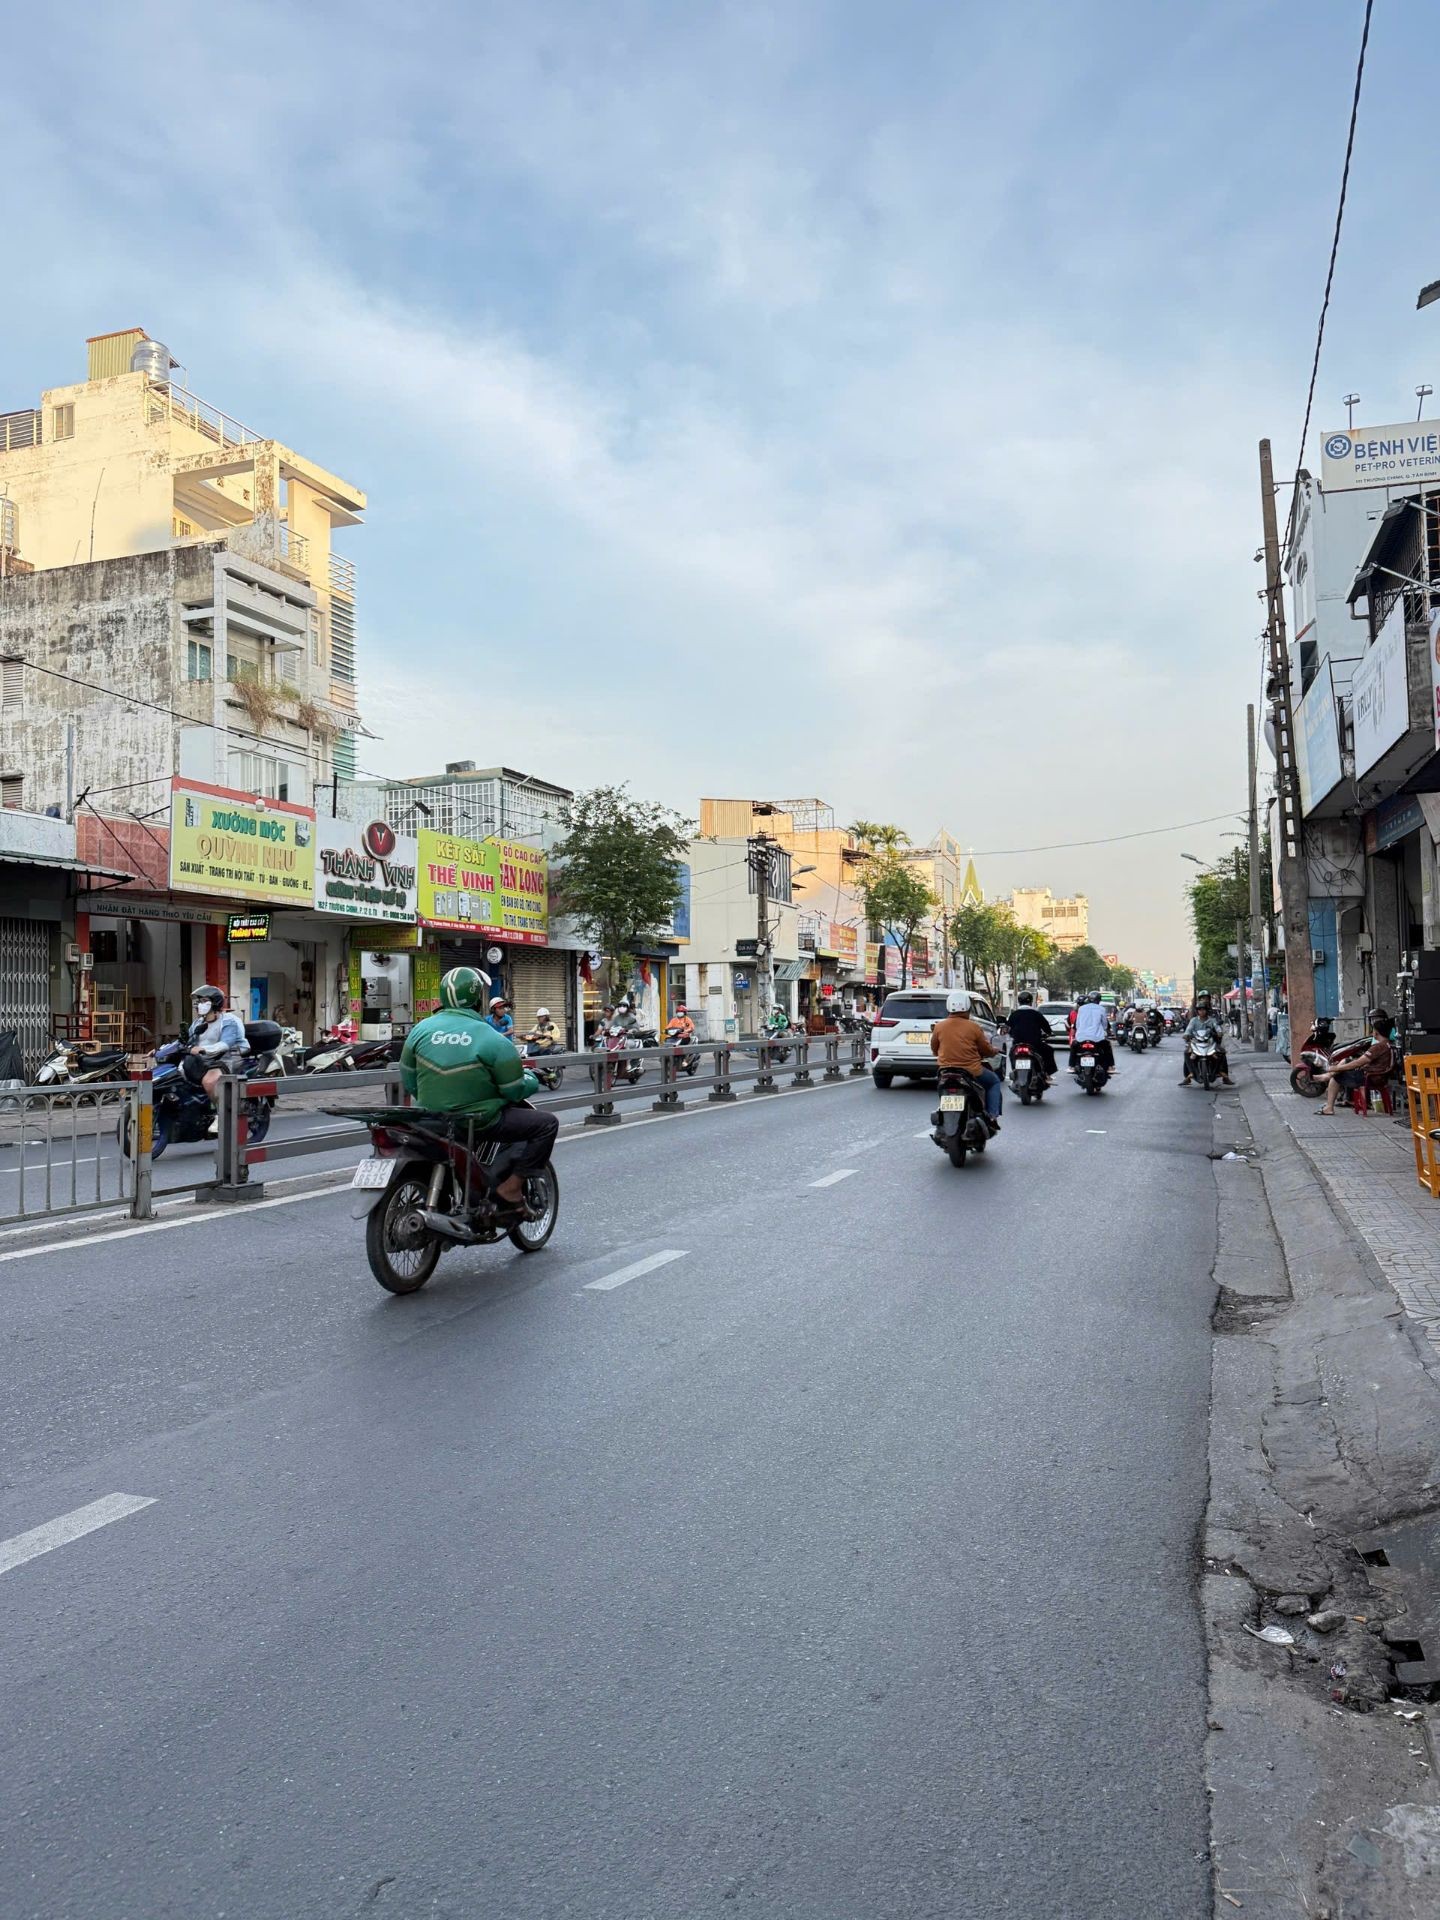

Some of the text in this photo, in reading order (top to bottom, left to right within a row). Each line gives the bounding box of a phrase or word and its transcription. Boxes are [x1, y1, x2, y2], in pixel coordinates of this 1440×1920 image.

[1355, 433, 1440, 460] BỆNH VIỆ
[1355, 460, 1396, 473] PET-PRO
[259, 820, 286, 842] MỘC
[196, 833, 298, 872] QUỲNH NHƯ
[437, 840, 460, 862] KÉT
[464, 843, 486, 866] SẮT
[514, 848, 528, 862] CAO
[320, 847, 416, 890] THÀNH VINH
[428, 863, 495, 894] THẾ VINH
[431, 1030, 472, 1046] Grab
